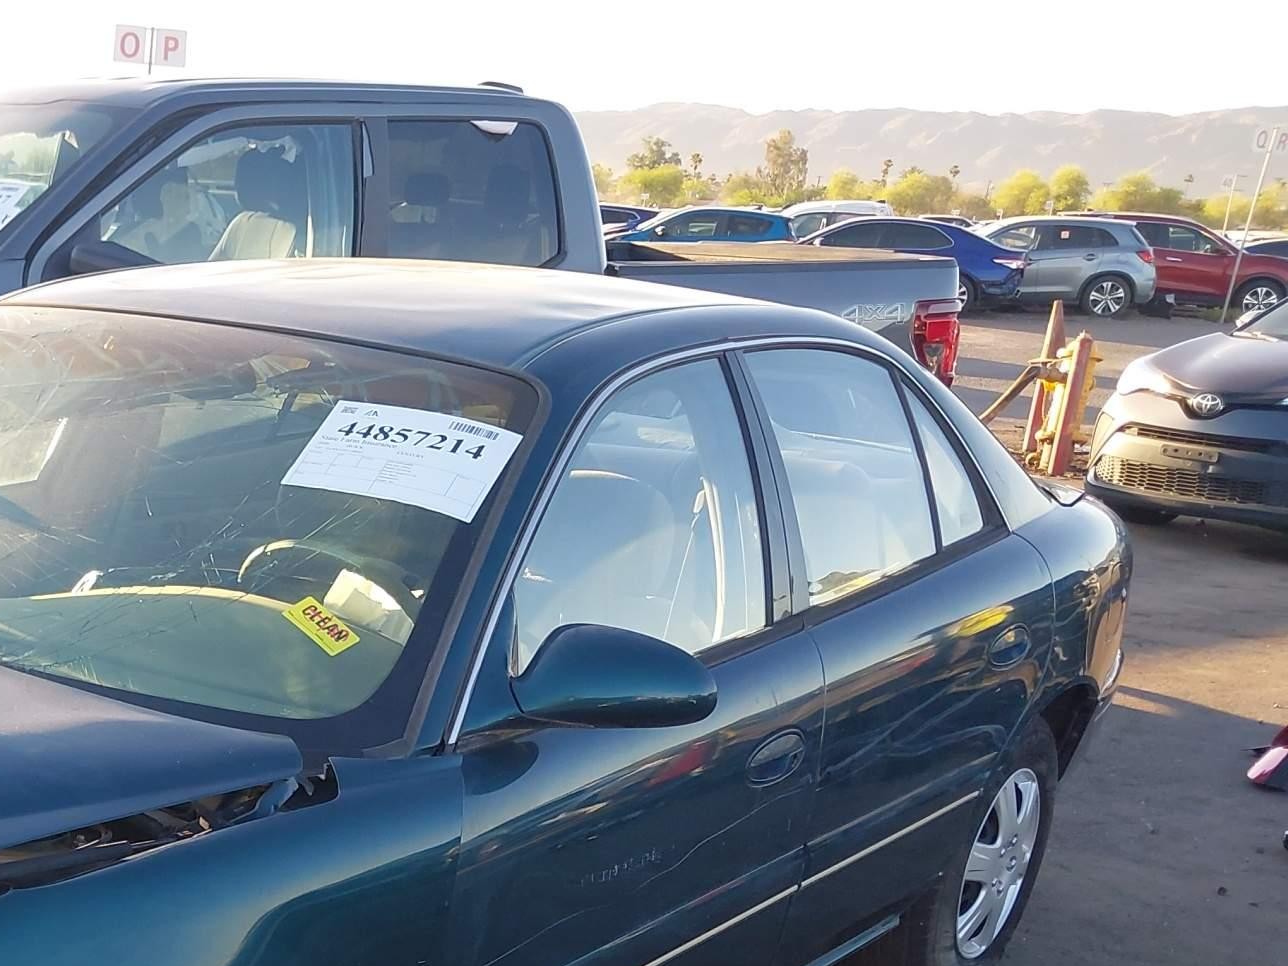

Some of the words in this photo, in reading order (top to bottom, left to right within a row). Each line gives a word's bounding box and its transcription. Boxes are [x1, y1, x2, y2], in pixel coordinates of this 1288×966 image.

[120, 32, 140, 58] O
[163, 35, 179, 61] P
[338, 421, 485, 459] 44857214
[340, 437, 360, 446] Farm
[302, 604, 349, 642] CLEAN
